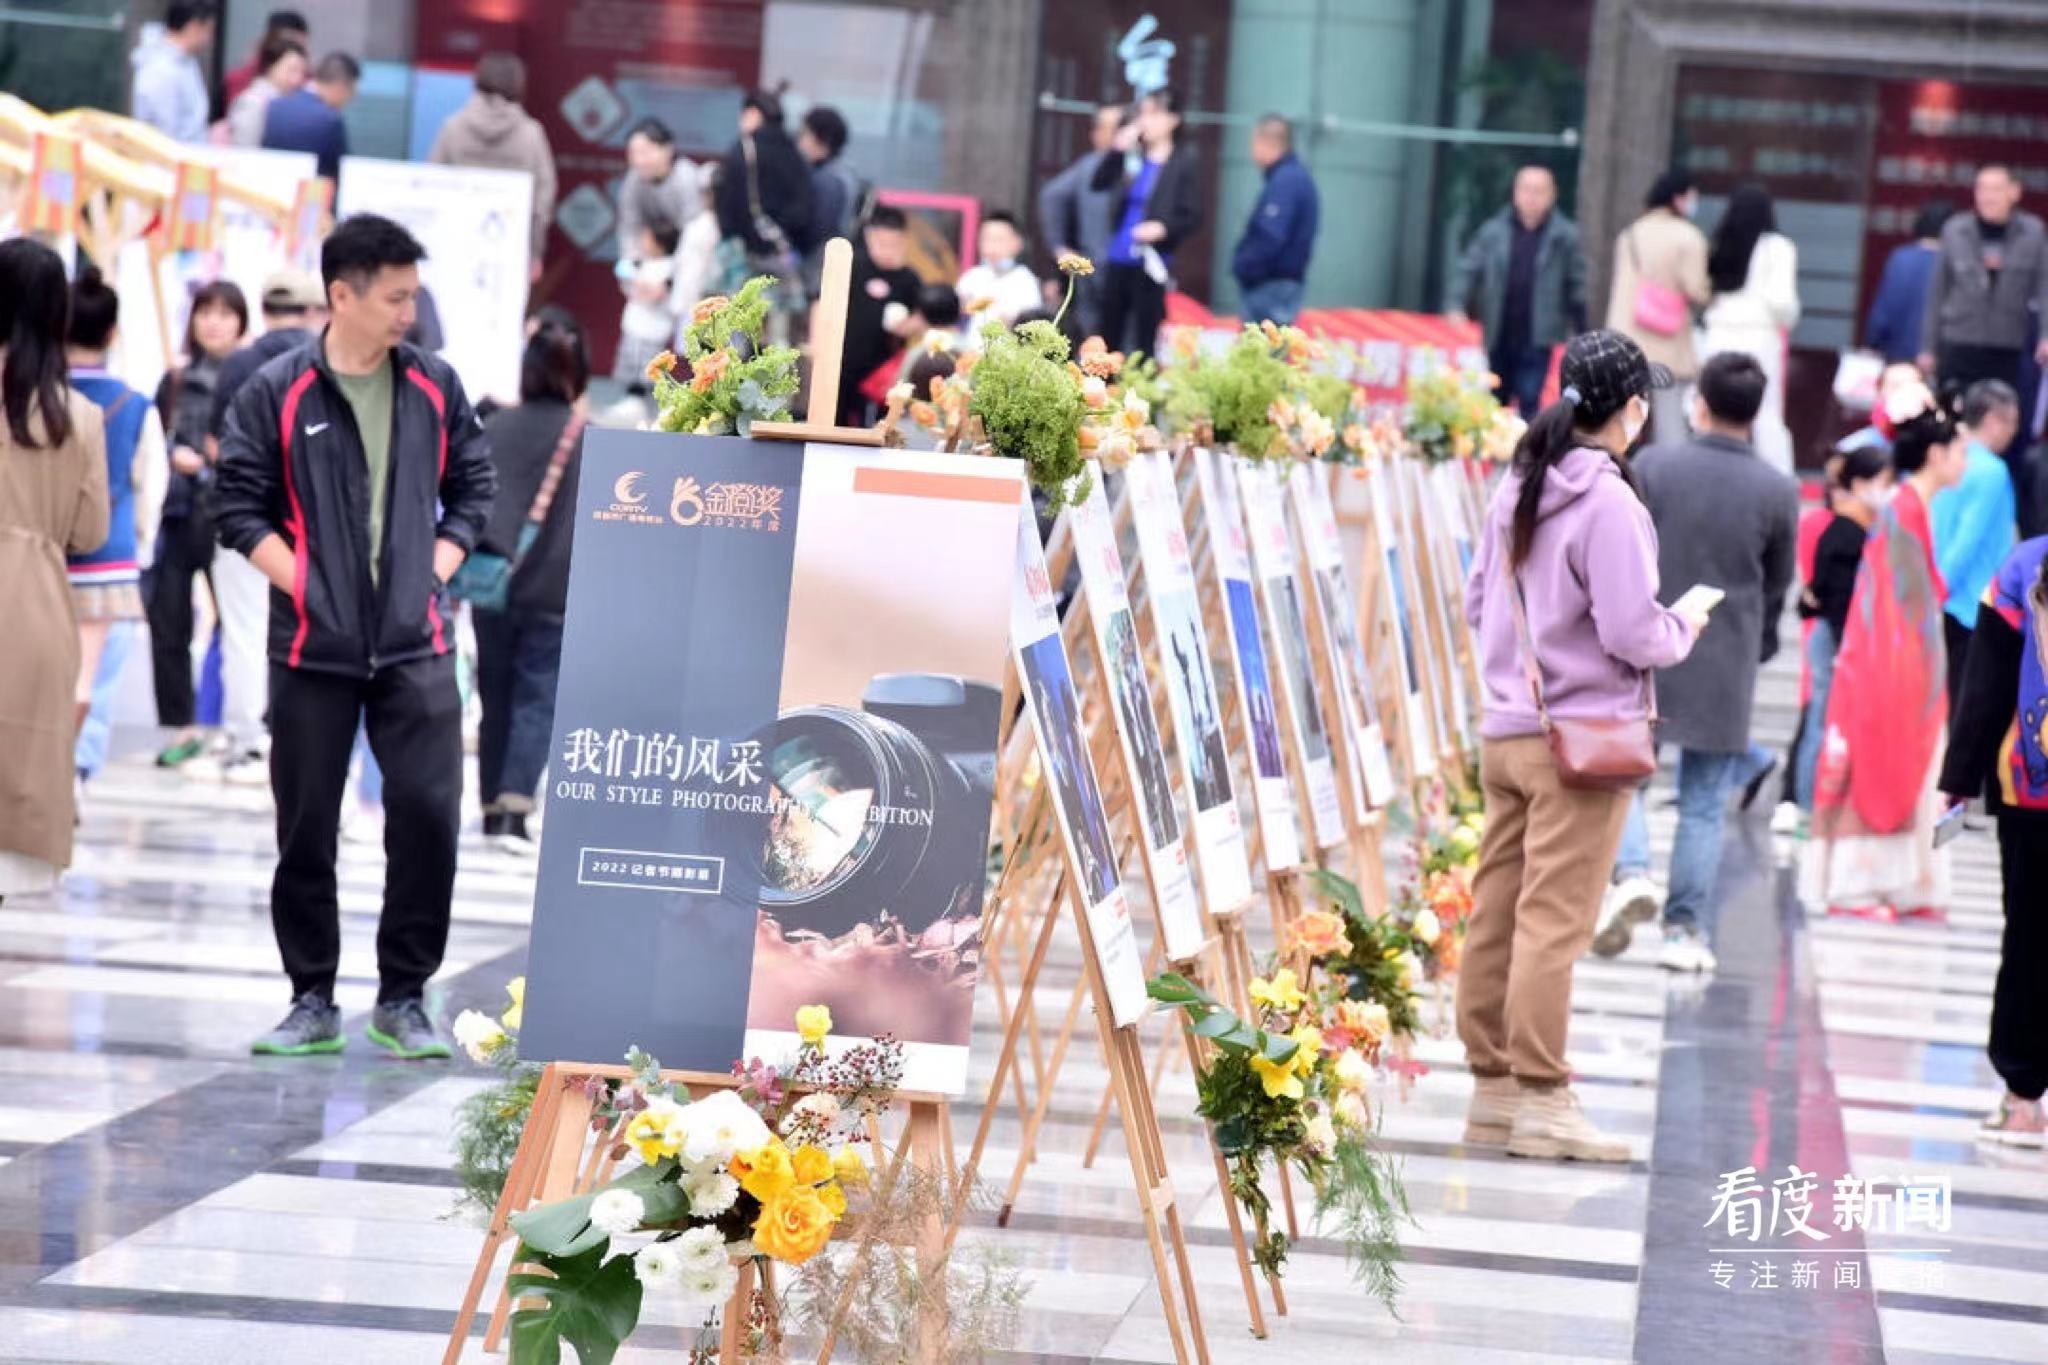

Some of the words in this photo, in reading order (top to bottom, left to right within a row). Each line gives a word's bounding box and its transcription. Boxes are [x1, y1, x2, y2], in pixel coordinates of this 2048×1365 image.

[563, 727, 763, 787] 我们的风采
[556, 780, 596, 801] OUR
[606, 784, 663, 806] STYLE
